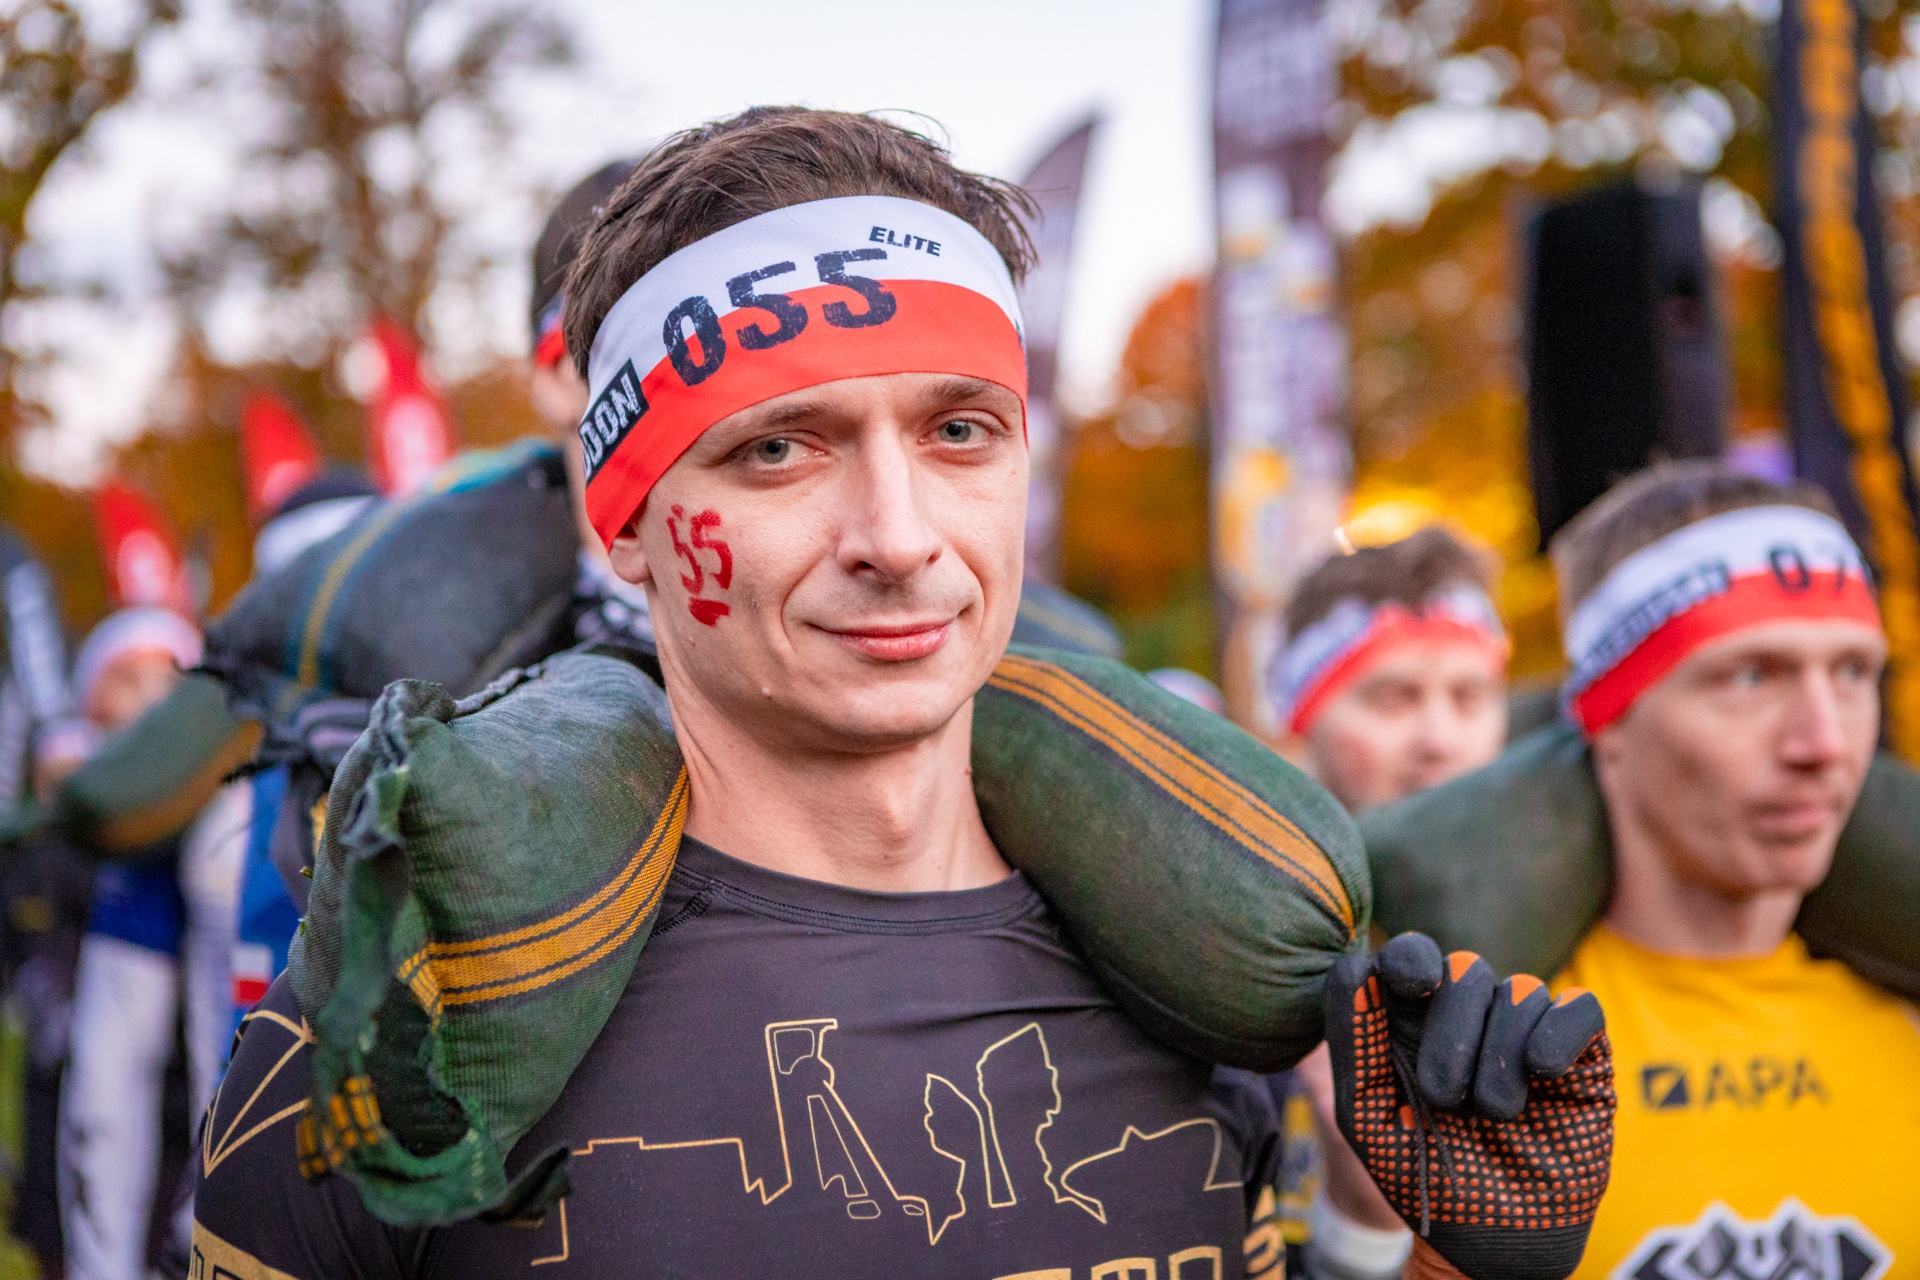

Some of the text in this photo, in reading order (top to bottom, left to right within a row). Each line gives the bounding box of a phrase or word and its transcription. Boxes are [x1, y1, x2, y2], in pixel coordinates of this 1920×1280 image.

[869, 226, 941, 257] ELITE
[663, 247, 896, 386] 055
[1768, 544, 1866, 594] 07
[1703, 1057, 1833, 1111] APA
